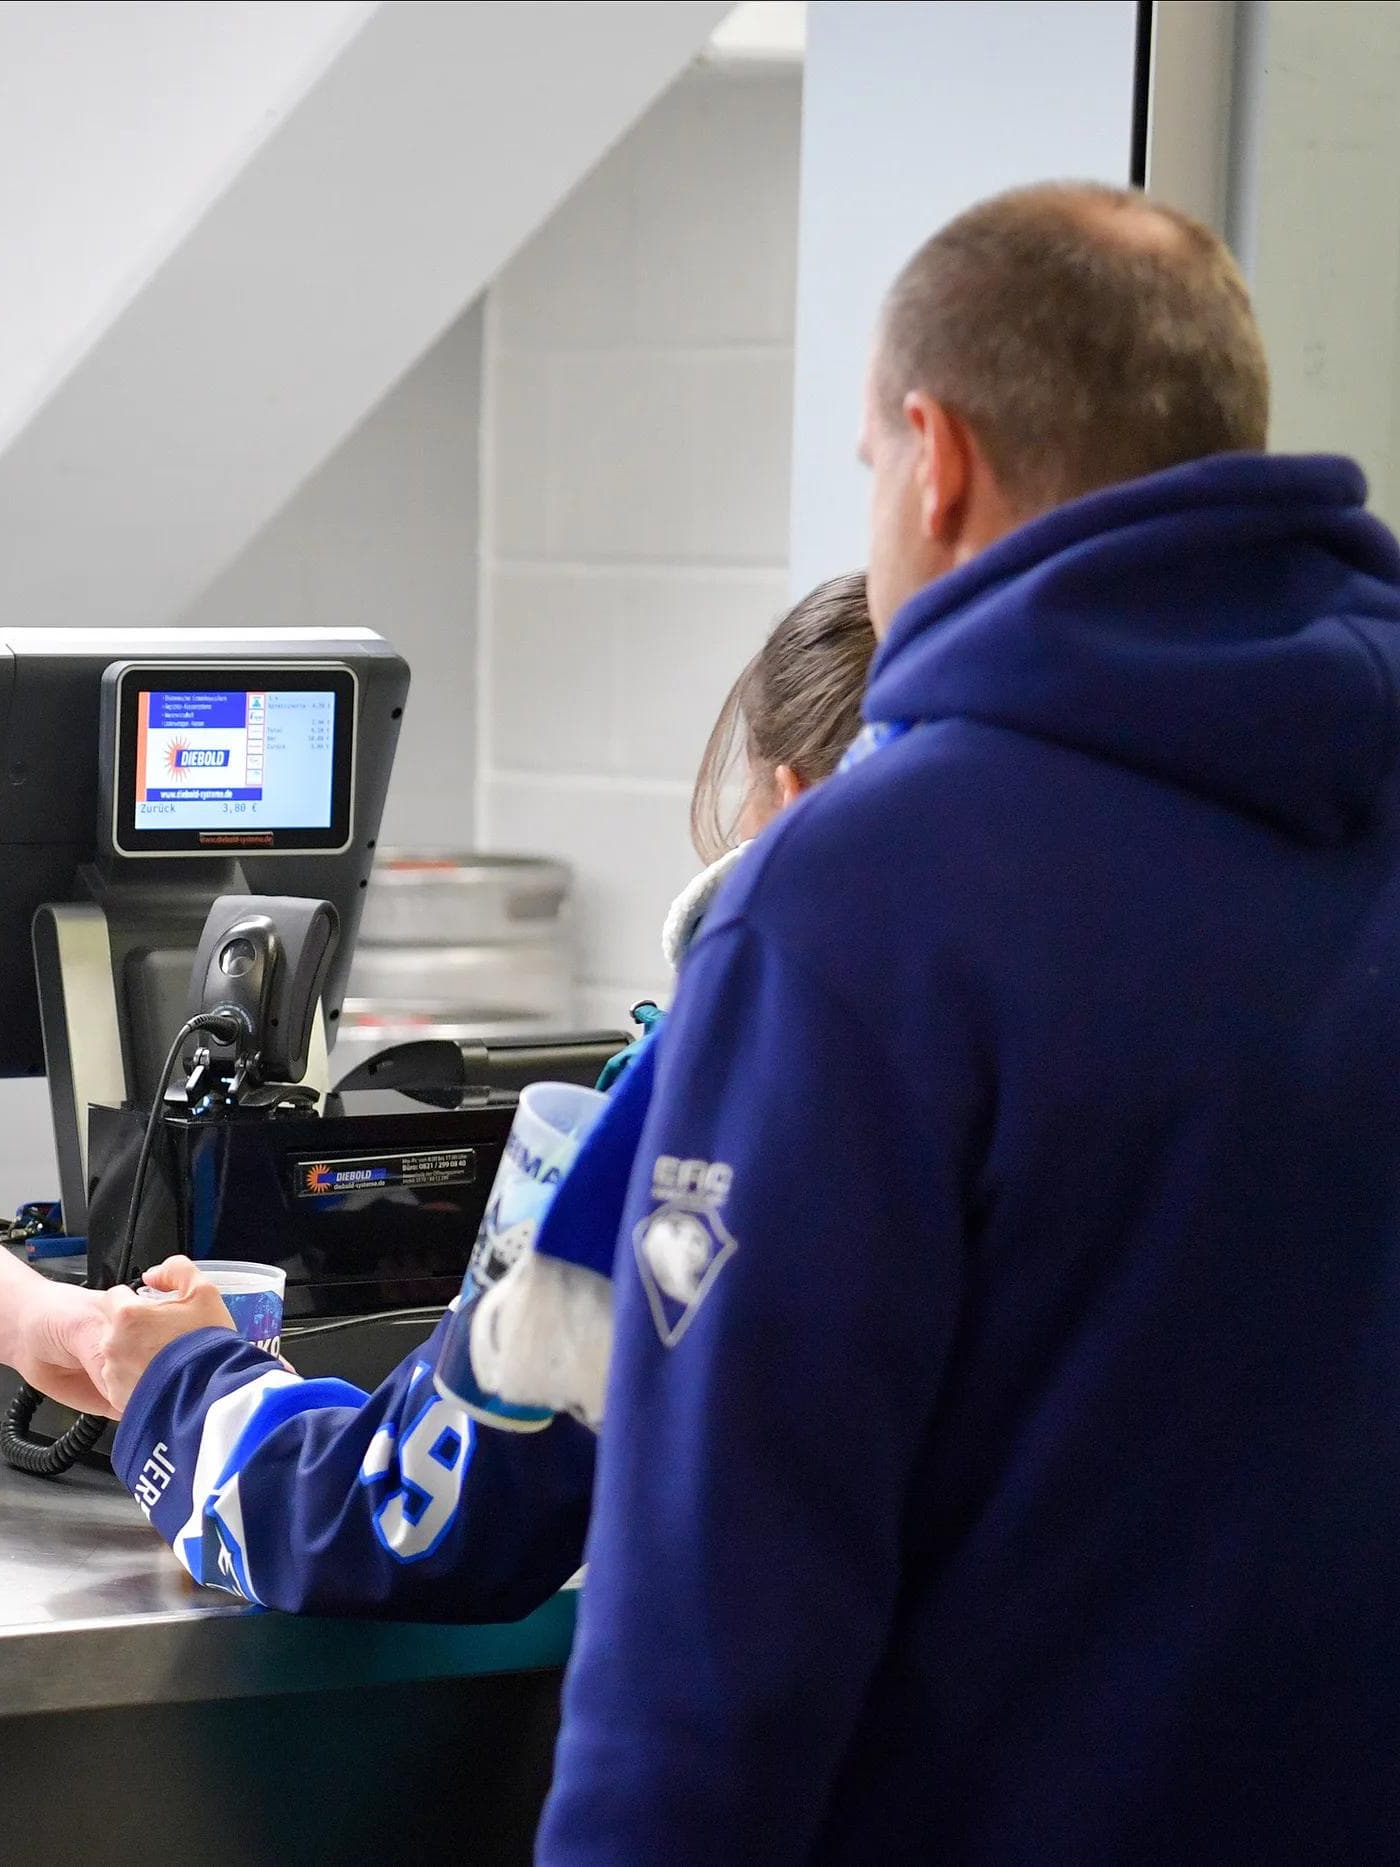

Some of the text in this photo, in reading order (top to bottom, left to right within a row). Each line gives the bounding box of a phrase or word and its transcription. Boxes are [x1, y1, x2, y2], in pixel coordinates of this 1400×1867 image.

[181, 751, 225, 766] DIEBOLD
[140, 803, 176, 813] Zurück
[223, 803, 246, 813] 3,80
[336, 1169, 372, 1182] DIEBOLD
[653, 1155, 734, 1192] ERC
